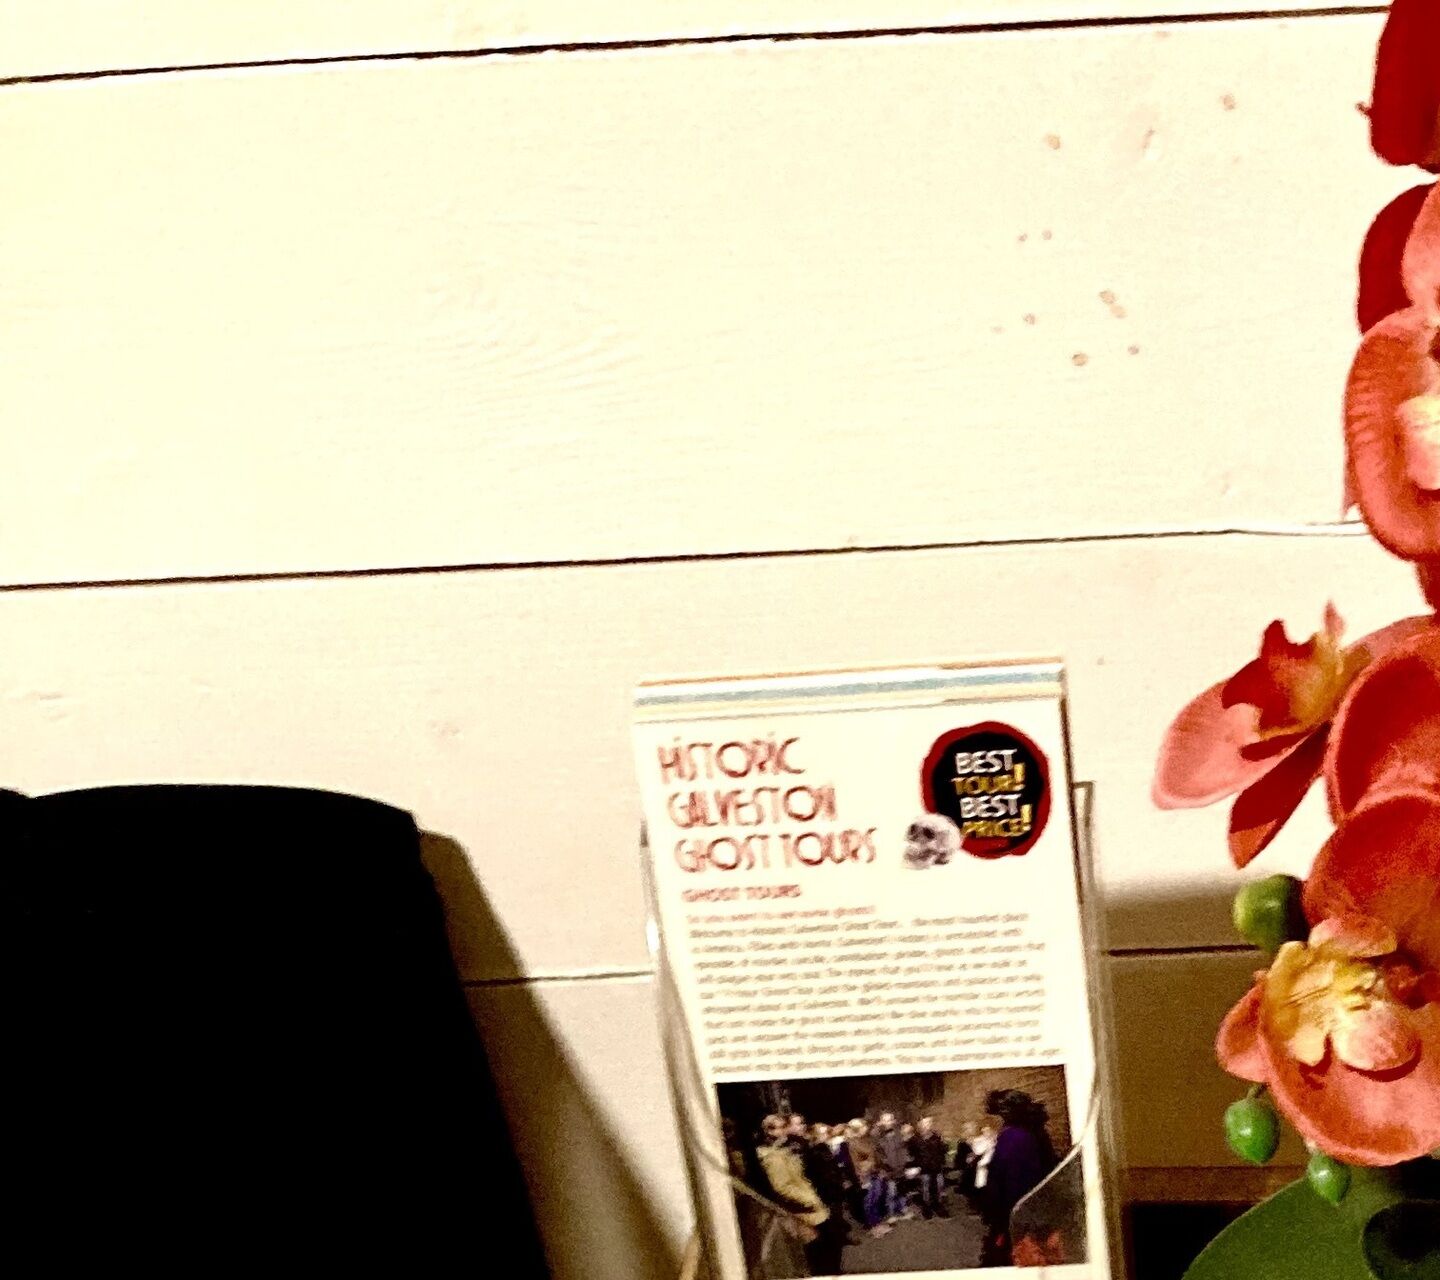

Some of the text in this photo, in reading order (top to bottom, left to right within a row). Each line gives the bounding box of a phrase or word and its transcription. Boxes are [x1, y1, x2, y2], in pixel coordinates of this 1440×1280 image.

[955, 749, 1017, 774] BEST
[668, 782, 837, 829] GALVESTON
[960, 794, 1021, 818] BEST
[674, 827, 877, 873] GHOST TOURS
